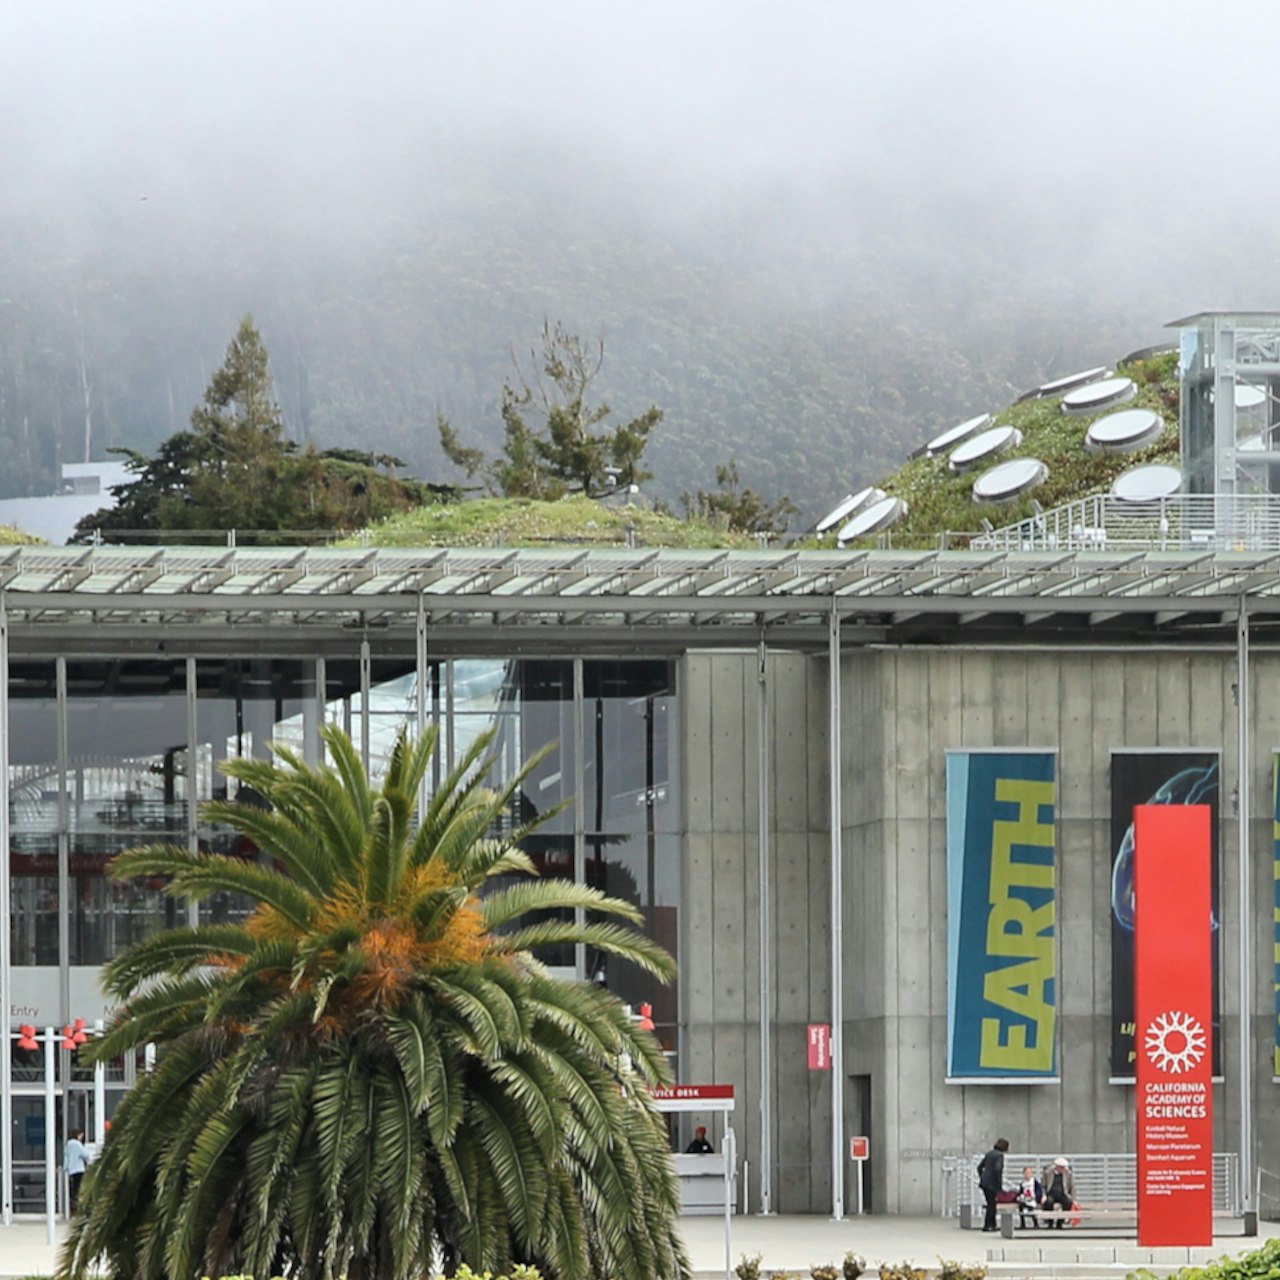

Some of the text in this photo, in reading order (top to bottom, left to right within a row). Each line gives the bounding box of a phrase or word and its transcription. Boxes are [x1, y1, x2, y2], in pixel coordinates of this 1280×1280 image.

[980, 778, 1056, 1071] EARTH
[10, 1005, 39, 1018] Entry
[676, 1088, 700, 1097] DESK
[1145, 1082, 1206, 1093] CALIFORNIA
[1145, 1094, 1206, 1105] ACADEMY OF
[1145, 1106, 1206, 1118] SCIENCES
